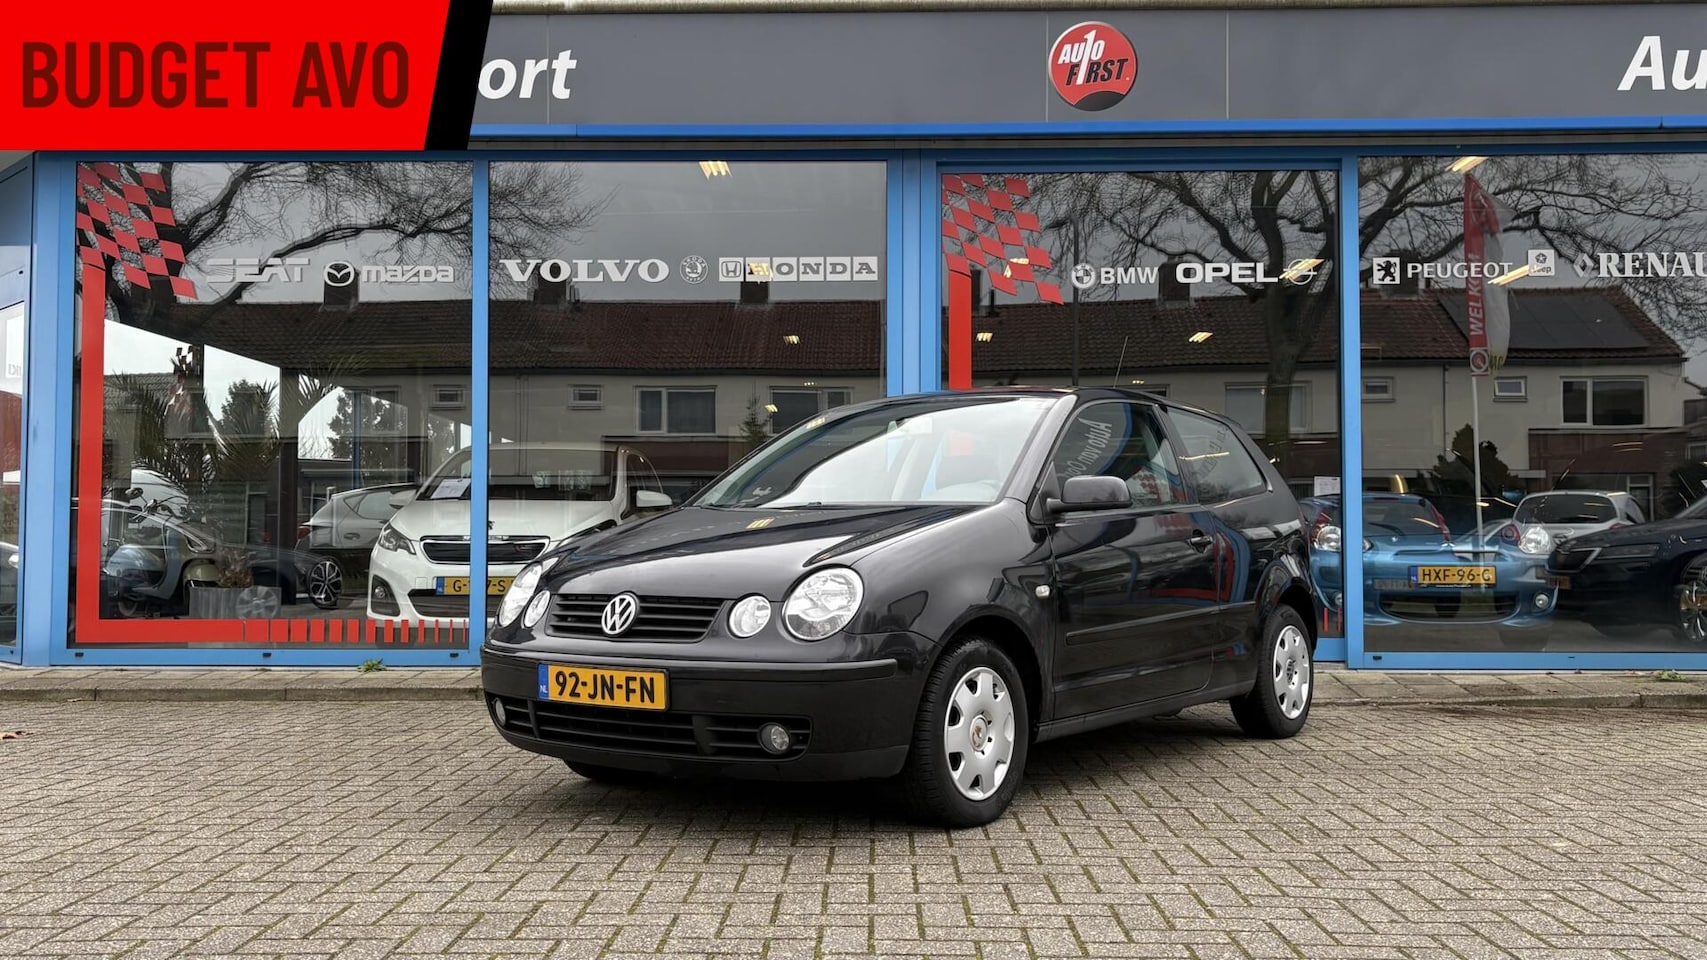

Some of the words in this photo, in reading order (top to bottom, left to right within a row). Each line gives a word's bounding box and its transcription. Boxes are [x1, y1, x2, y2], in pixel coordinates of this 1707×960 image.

[206, 257, 311, 284] SEAT
[499, 258, 671, 283] VOLVO
[746, 260, 877, 278] HONDA
[1100, 267, 1159, 284] BMW
[1175, 262, 1279, 284] OPEL
[1407, 262, 1513, 279] PEUGEOT
[1467, 253, 1484, 336] WELK
[1421, 568, 1493, 583] HXF-96-G
[555, 670, 655, 704] 92-JN-FN
